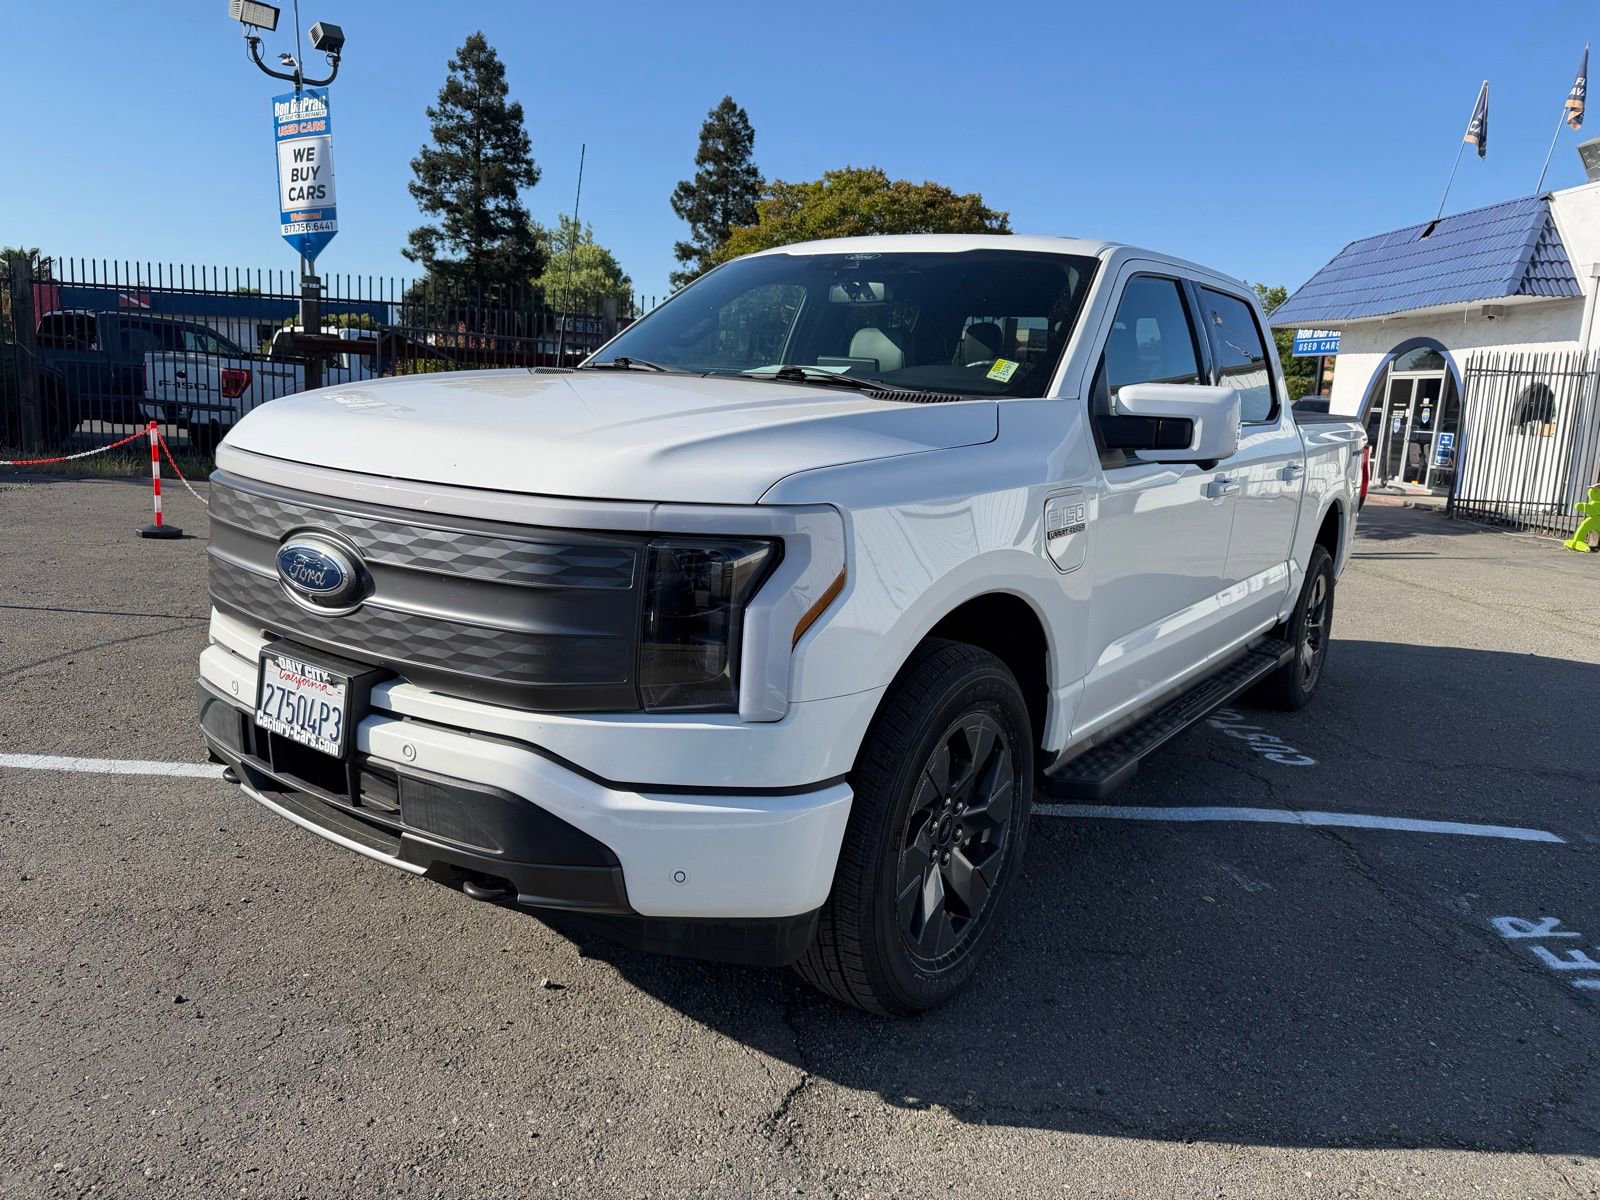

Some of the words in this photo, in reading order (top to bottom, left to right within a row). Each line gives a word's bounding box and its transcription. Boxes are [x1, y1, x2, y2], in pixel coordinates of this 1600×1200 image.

[275, 102, 290, 117] Ron
[299, 120, 326, 133] CARS
[293, 146, 315, 163] WE
[291, 165, 320, 183] BUY
[288, 184, 326, 202] CARS
[283, 221, 334, 234] 877.756.6441
[1298, 342, 1317, 352] USED
[1320, 341, 1340, 350] CARS
[1047, 502, 1086, 530] F-150
[288, 553, 326, 587] Ford
[278, 657, 303, 676] DALY
[304, 667, 329, 682] CITY
[263, 682, 342, 742] 27504P3
